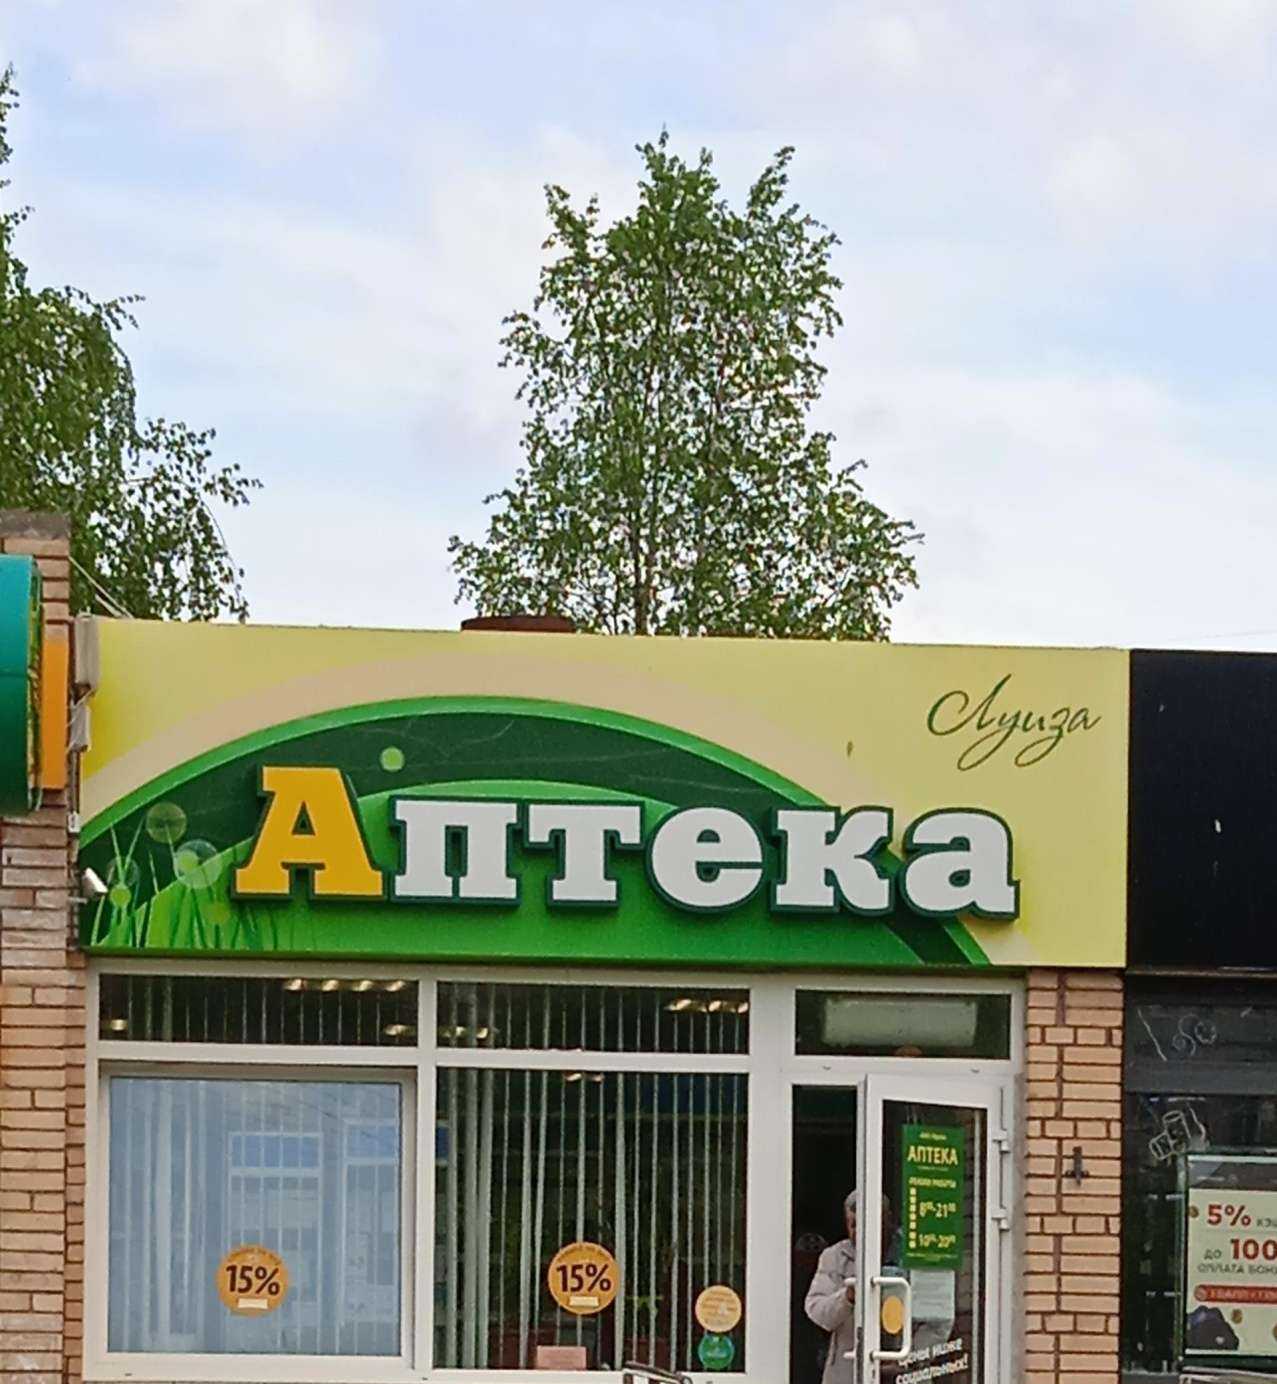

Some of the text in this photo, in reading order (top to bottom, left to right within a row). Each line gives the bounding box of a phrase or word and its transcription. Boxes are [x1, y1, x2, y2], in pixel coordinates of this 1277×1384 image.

[927, 673, 1102, 772] Луиза
[231, 765, 1020, 918] Аптека
[907, 1145, 959, 1166] АПТЕКА
[1206, 1203, 1252, 1228] 5%
[225, 1264, 281, 1297] 15%
[555, 1262, 613, 1293] 15%
